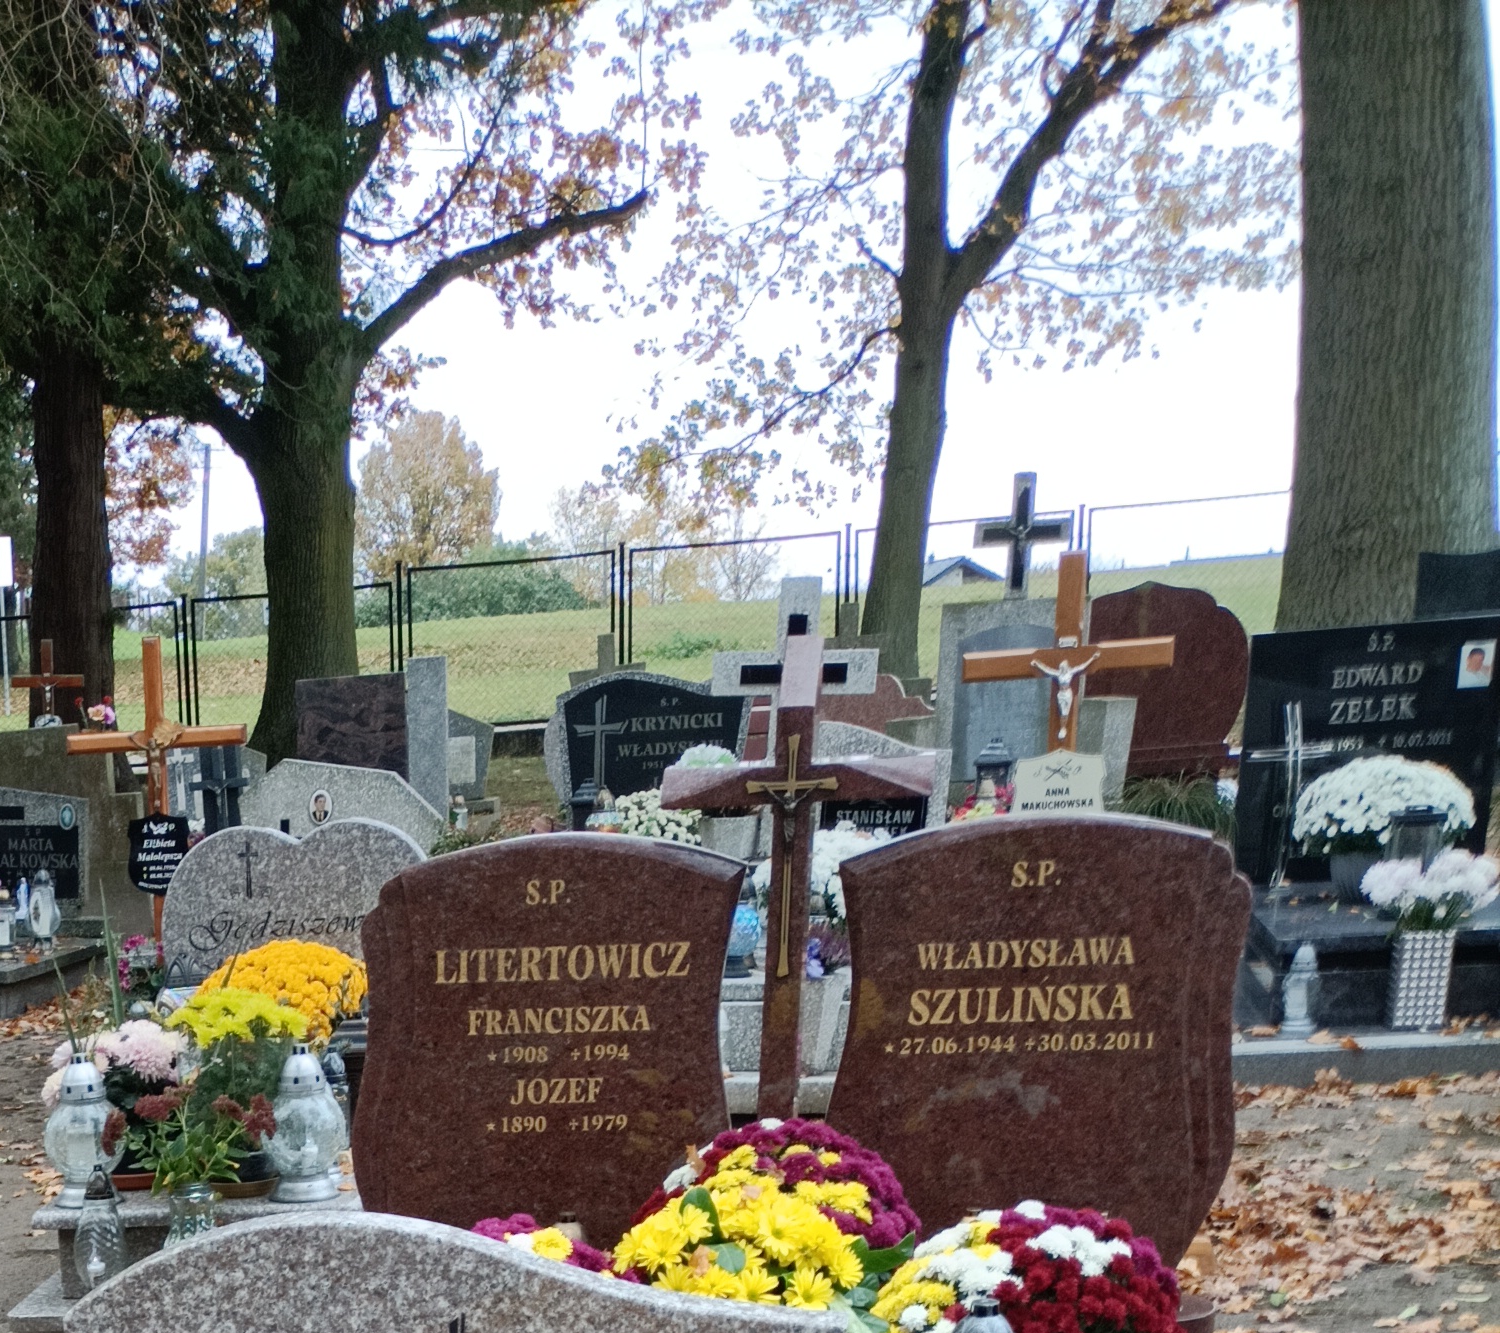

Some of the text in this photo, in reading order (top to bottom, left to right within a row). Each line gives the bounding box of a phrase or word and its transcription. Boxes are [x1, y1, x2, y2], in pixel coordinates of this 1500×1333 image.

[1331, 661, 1425, 690] EDWARD
[630, 712, 723, 732] KRYNICKI
[1328, 692, 1418, 725] ZELEK
[1021, 798, 1094, 811] MAKUCHOWSKA
[1045, 788, 1070, 797] ANNA
[836, 809, 915, 825] STANISŁAW
[8, 838, 54, 851] MARTA
[435, 941, 691, 984] LITERTOWICZ
[917, 936, 1135, 971] WŁADYSŁAWA
[907, 975, 1134, 1026] SZULIŃSKA
[467, 1005, 651, 1036] FRANCISZKA
